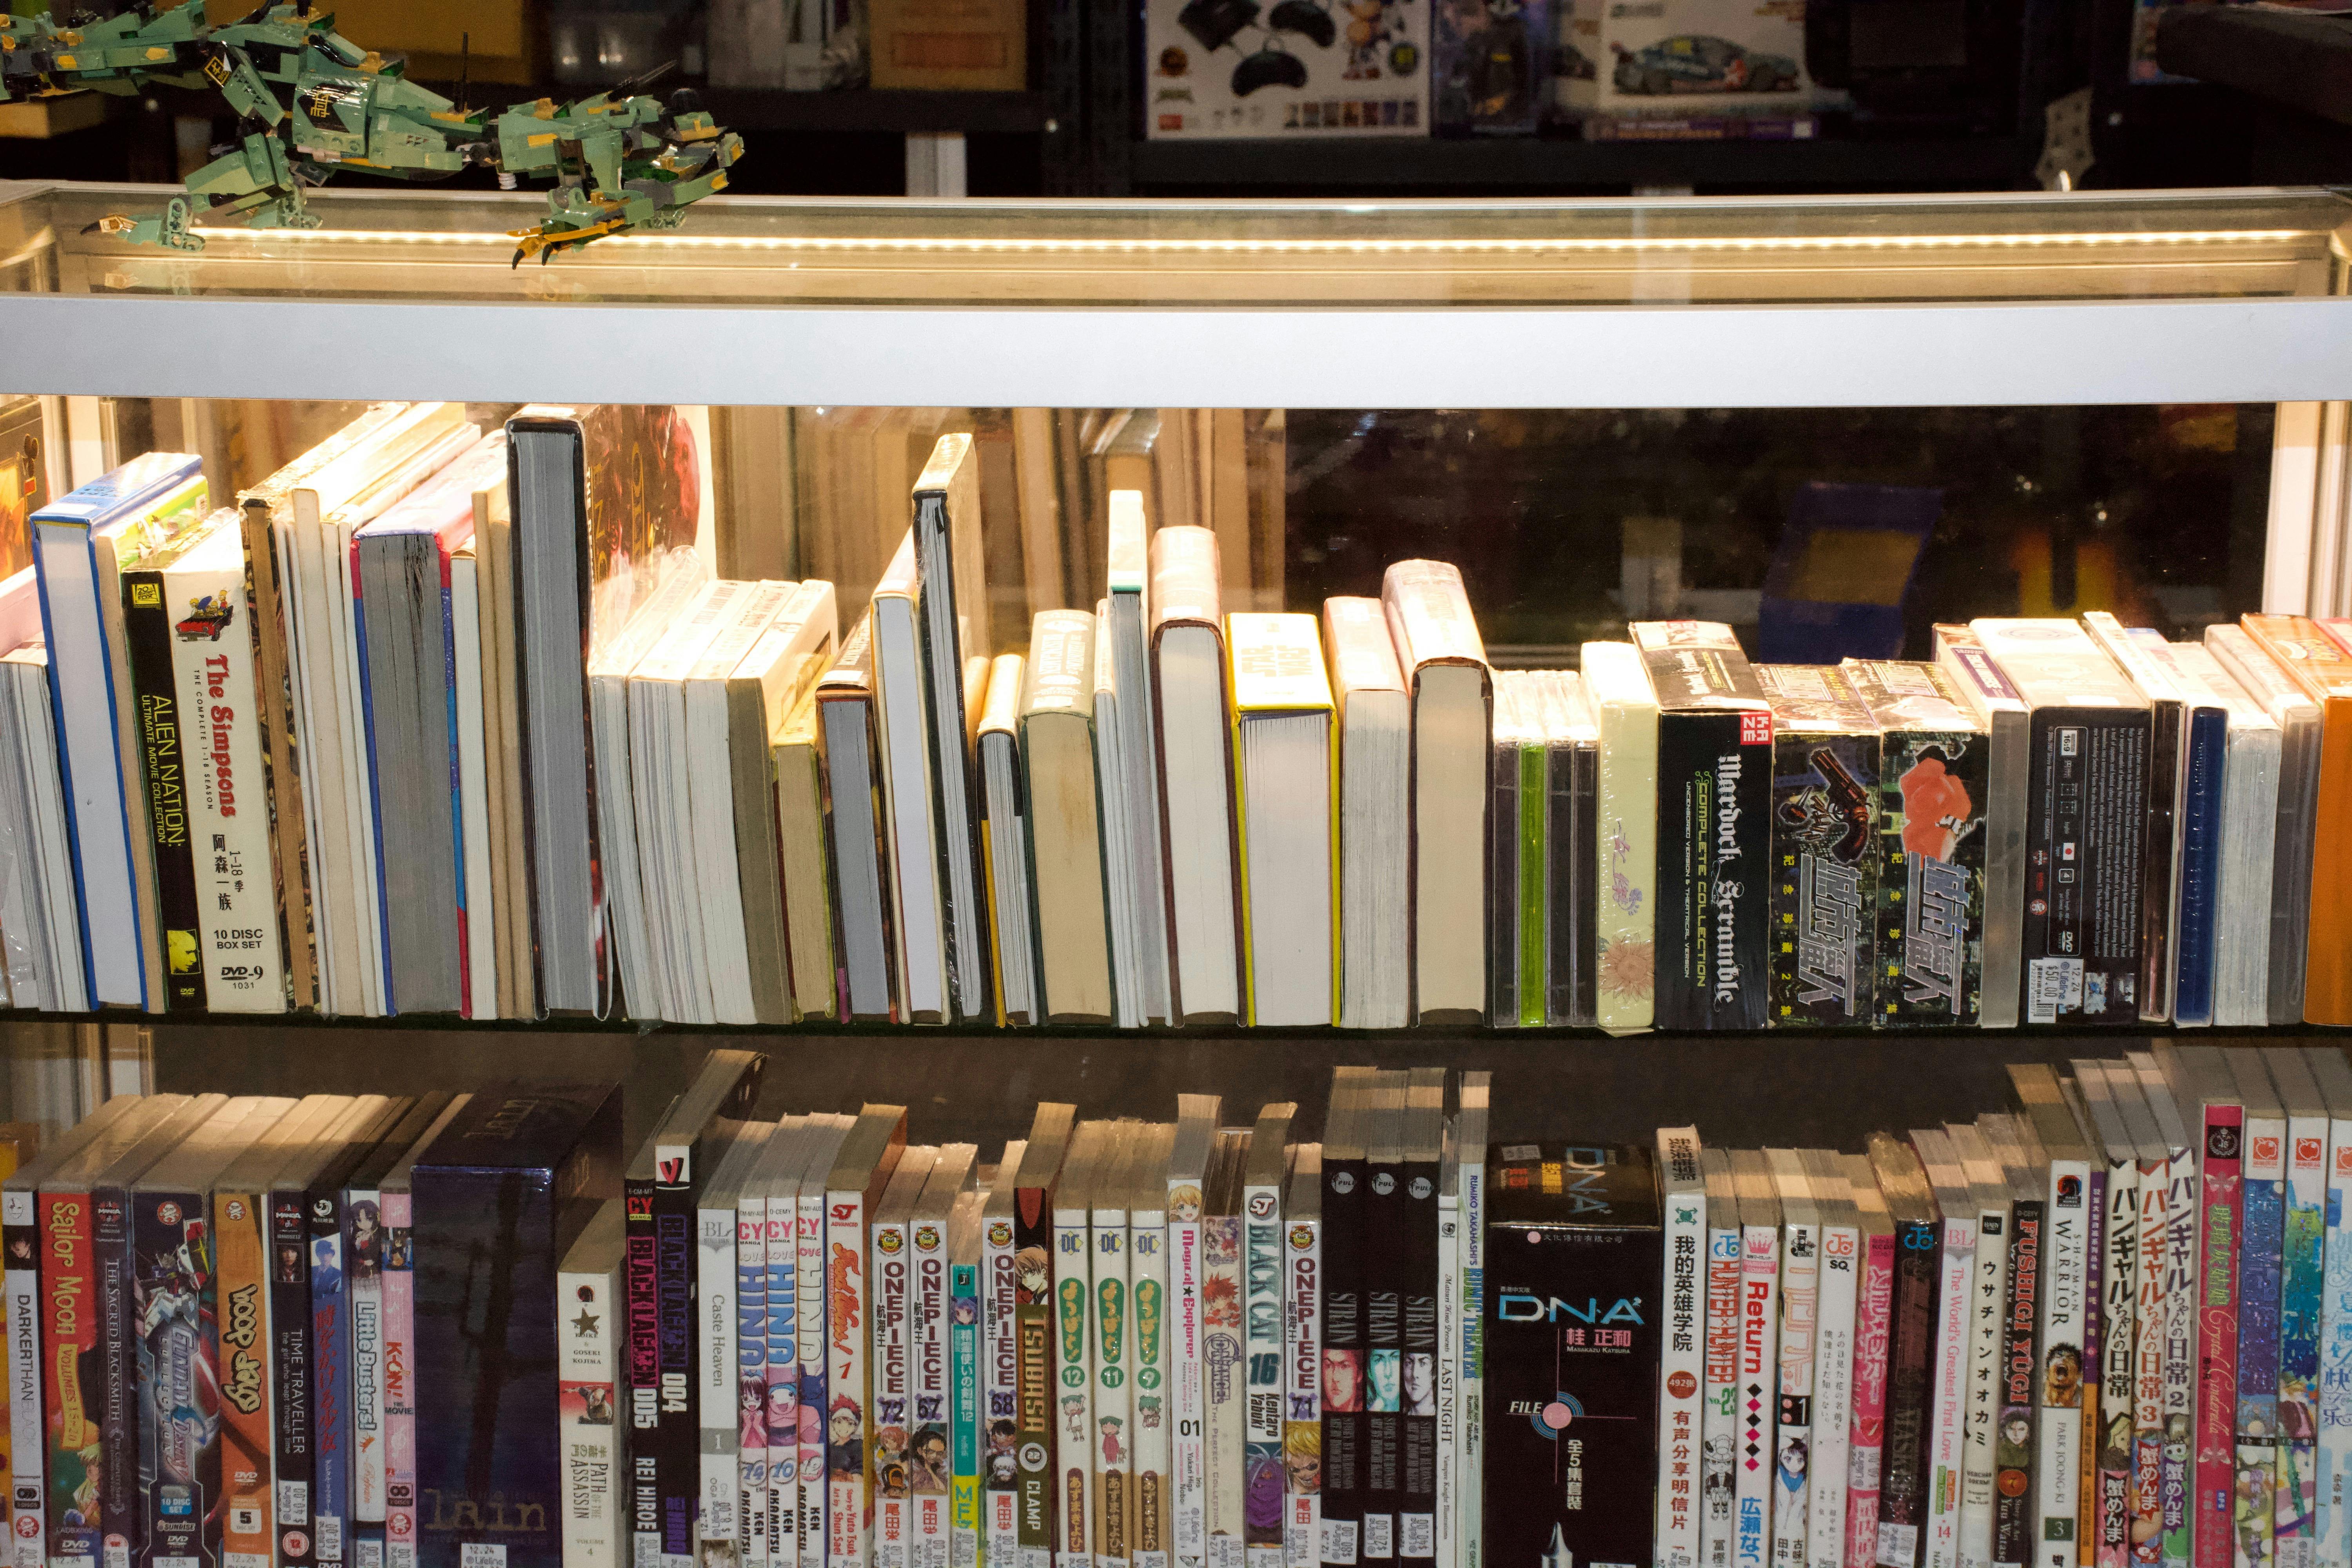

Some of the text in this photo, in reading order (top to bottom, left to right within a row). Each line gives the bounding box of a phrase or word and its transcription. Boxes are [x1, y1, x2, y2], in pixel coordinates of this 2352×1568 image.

[1241, 645, 1277, 677] STAR
[153, 695, 176, 755] ALIEN
[206, 653, 236, 818] The Simpsons
[142, 694, 165, 843] ULTIMATE MOVIE COLLECTION
[196, 691, 207, 740] COMPLETE
[205, 773, 213, 810] SEASON
[212, 834, 232, 911] 阿森一族
[1697, 782, 1708, 987] COMPLETE COLLECTION
[214, 929, 263, 939] 10 DISC
[2044, 965, 2059, 998] $50.00
[2058, 970, 2069, 1000] Lifeline
[2071, 967, 2081, 992] 12.24
[628, 1197, 653, 1214] CY
[1469, 1175, 1478, 1266] RUMIKO TAKAHASHI'S
[739, 1222, 763, 1240] CY
[767, 1220, 793, 1238] CY
[1060, 1234, 1080, 1253] DC
[1101, 1233, 1120, 1252] DC
[1138, 1235, 1158, 1254] DC
[49, 1201, 83, 1334] Sailor Moon
[2014, 1219, 2039, 1332] FUSHIGI
[2051, 1219, 2073, 1327] WARRIOR
[1182, 1230, 1195, 1359] Magical Explorer
[1249, 1223, 1280, 1386] BLACK CAT 16
[1672, 1235, 1696, 1352] 我的英雄学院
[2108, 1187, 2138, 1399] バンギャルちゃんの日常
[2139, 1189, 2169, 1422] バンギャルちゃんの日常 3
[2165, 1176, 2194, 1408] バンギャルちゃんの日常 2
[768, 1263, 795, 1365] HINA
[1328, 1292, 1357, 1343] STRAIN
[1369, 1292, 1399, 1343] STRAIN
[1405, 1295, 1435, 1347] STRAIN
[1444, 1274, 1452, 1353] Matsuri Hino Presents
[1744, 1280, 1769, 1374] Return
[107, 1261, 122, 1421] THE SACRED BLACKSMITH
[712, 1294, 724, 1387] Caste Heaven
[1566, 1327, 1632, 1347] 桂 正和
[1975, 1261, 1996, 1446] ウサチャンオオカミ
[61, 1349, 77, 1403] VOLUMES
[840, 1361, 851, 1379] 1
[1064, 1369, 1081, 1385] 12
[1103, 1369, 1119, 1385] 11
[1143, 1371, 1155, 1386] 9
[1940, 1268, 1965, 1461] The World's Greatest First Love
[290, 1328, 305, 1454] TIME TRAVELLER
[385, 1407, 414, 1415] MOVIE
[633, 1388, 658, 1428] 005
[662, 1373, 687, 1413] 004
[917, 1397, 941, 1419] 67
[991, 1392, 1014, 1415] 68
[1250, 1392, 1265, 1430] Yabuki
[1292, 1397, 1313, 1418] 71
[1441, 1358, 1453, 1445] LAST NIGHT
[1509, 1401, 1543, 1414] FILE
[282, 1405, 290, 1434] through
[881, 1400, 904, 1423] 72
[1180, 1419, 1200, 1437] 01
[1265, 1392, 1280, 1437] Kentaro
[715, 1434, 721, 1450] 1
[2055, 1421, 2067, 1503] PARK JOONG-KI
[570, 1459, 590, 1519] ASSASSIN
[591, 1462, 608, 1493] PATH
[772, 1463, 794, 1478] 10
[1670, 1410, 1692, 1531] 有声分享明信片
[423, 1489, 547, 1531] lain
[636, 1457, 657, 1530] REI HIROE
[1026, 1480, 1042, 1530] CLAMP
[240, 1511, 252, 1524] 5
[741, 1489, 751, 1554] AKAMATSU
[754, 1511, 764, 1536] KEN
[769, 1488, 780, 1554] AKAMATSU
[783, 1509, 793, 1534] KEN
[799, 1485, 807, 1551] AKAMATSU
[810, 1506, 820, 1531] KEN
[833, 1512, 843, 1535] Shun
[847, 1512, 857, 1534] Yuto
[1937, 1526, 1951, 1538] 14
[2053, 1521, 2064, 1537] 3
[62, 1540, 90, 1548] DVD
[470, 1546, 494, 1554] 12.24
